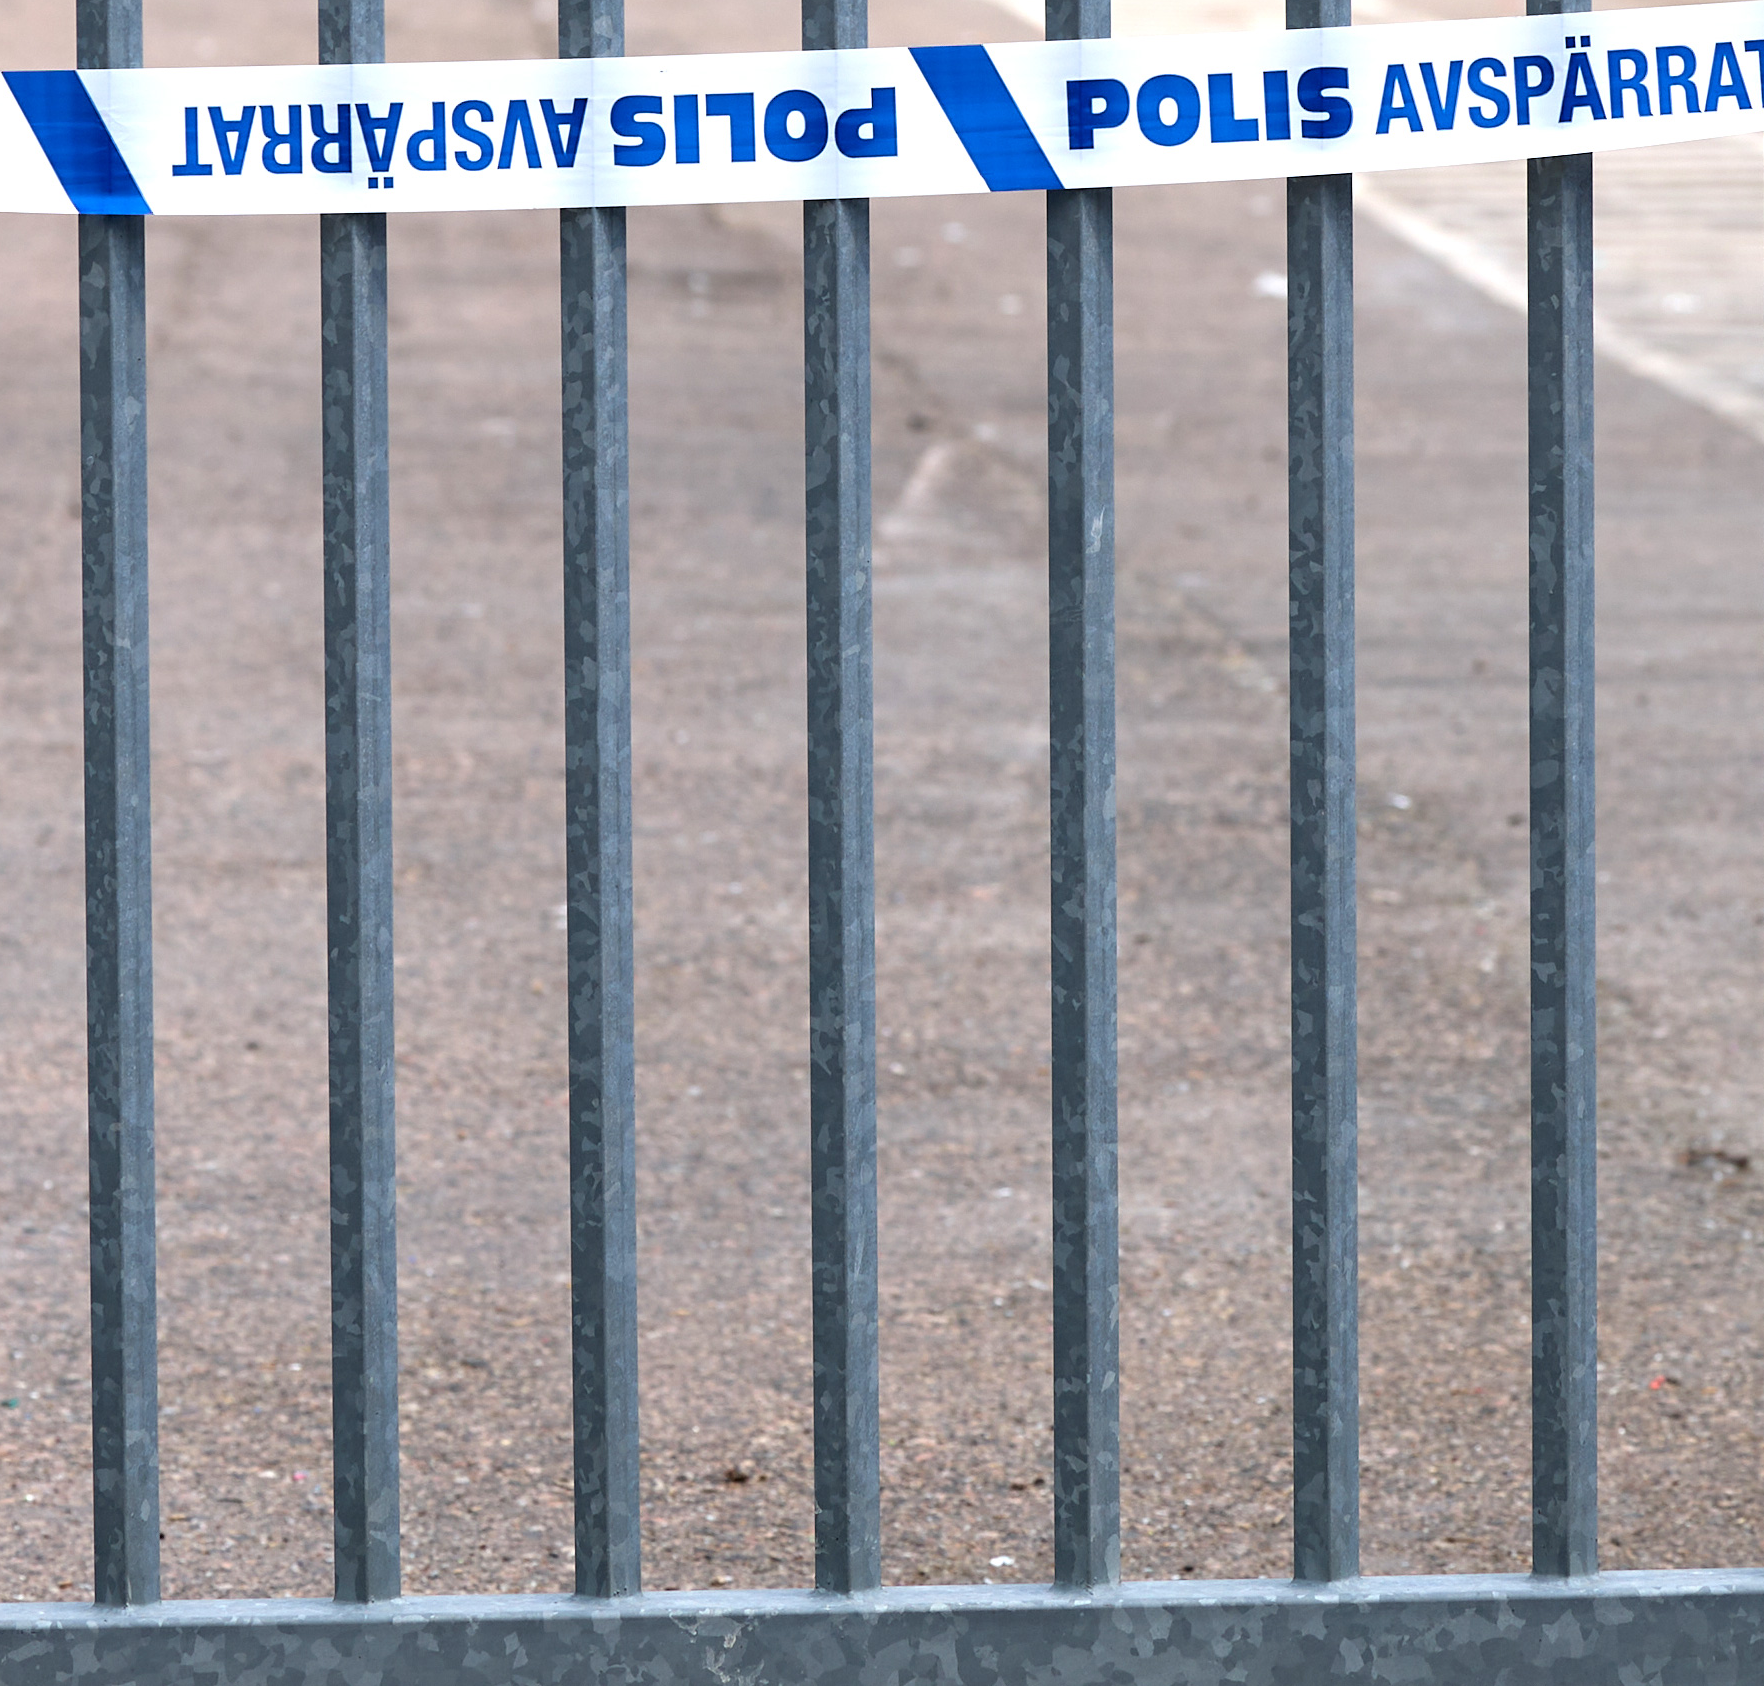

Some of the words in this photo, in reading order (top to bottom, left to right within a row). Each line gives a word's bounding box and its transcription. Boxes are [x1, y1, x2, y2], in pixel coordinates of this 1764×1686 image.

[171, 97, 589, 190] AVSPÄRRAT
[609, 86, 899, 168] POLIS
[1065, 65, 1355, 151] POLIS
